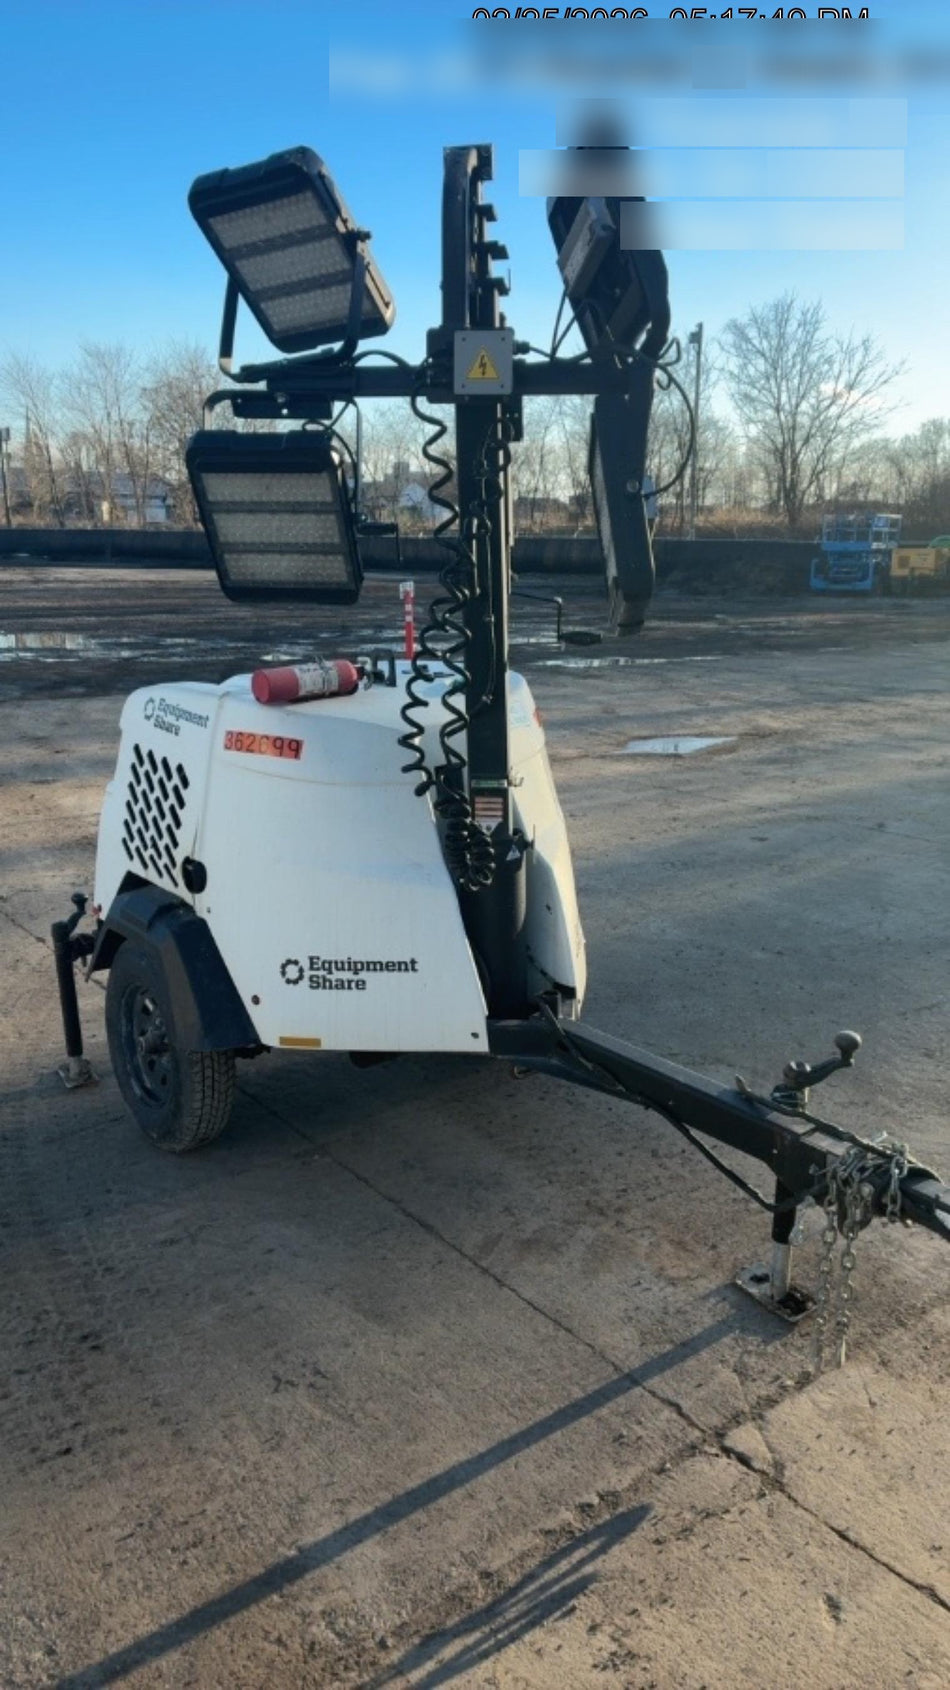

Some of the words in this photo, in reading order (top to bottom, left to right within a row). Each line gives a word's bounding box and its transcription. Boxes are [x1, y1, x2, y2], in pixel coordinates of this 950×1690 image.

[157, 698, 209, 728] Equipment
[153, 715, 181, 736] Share
[225, 731, 301, 759] 362699
[308, 955, 418, 975] Equipment
[308, 974, 367, 990] Share
